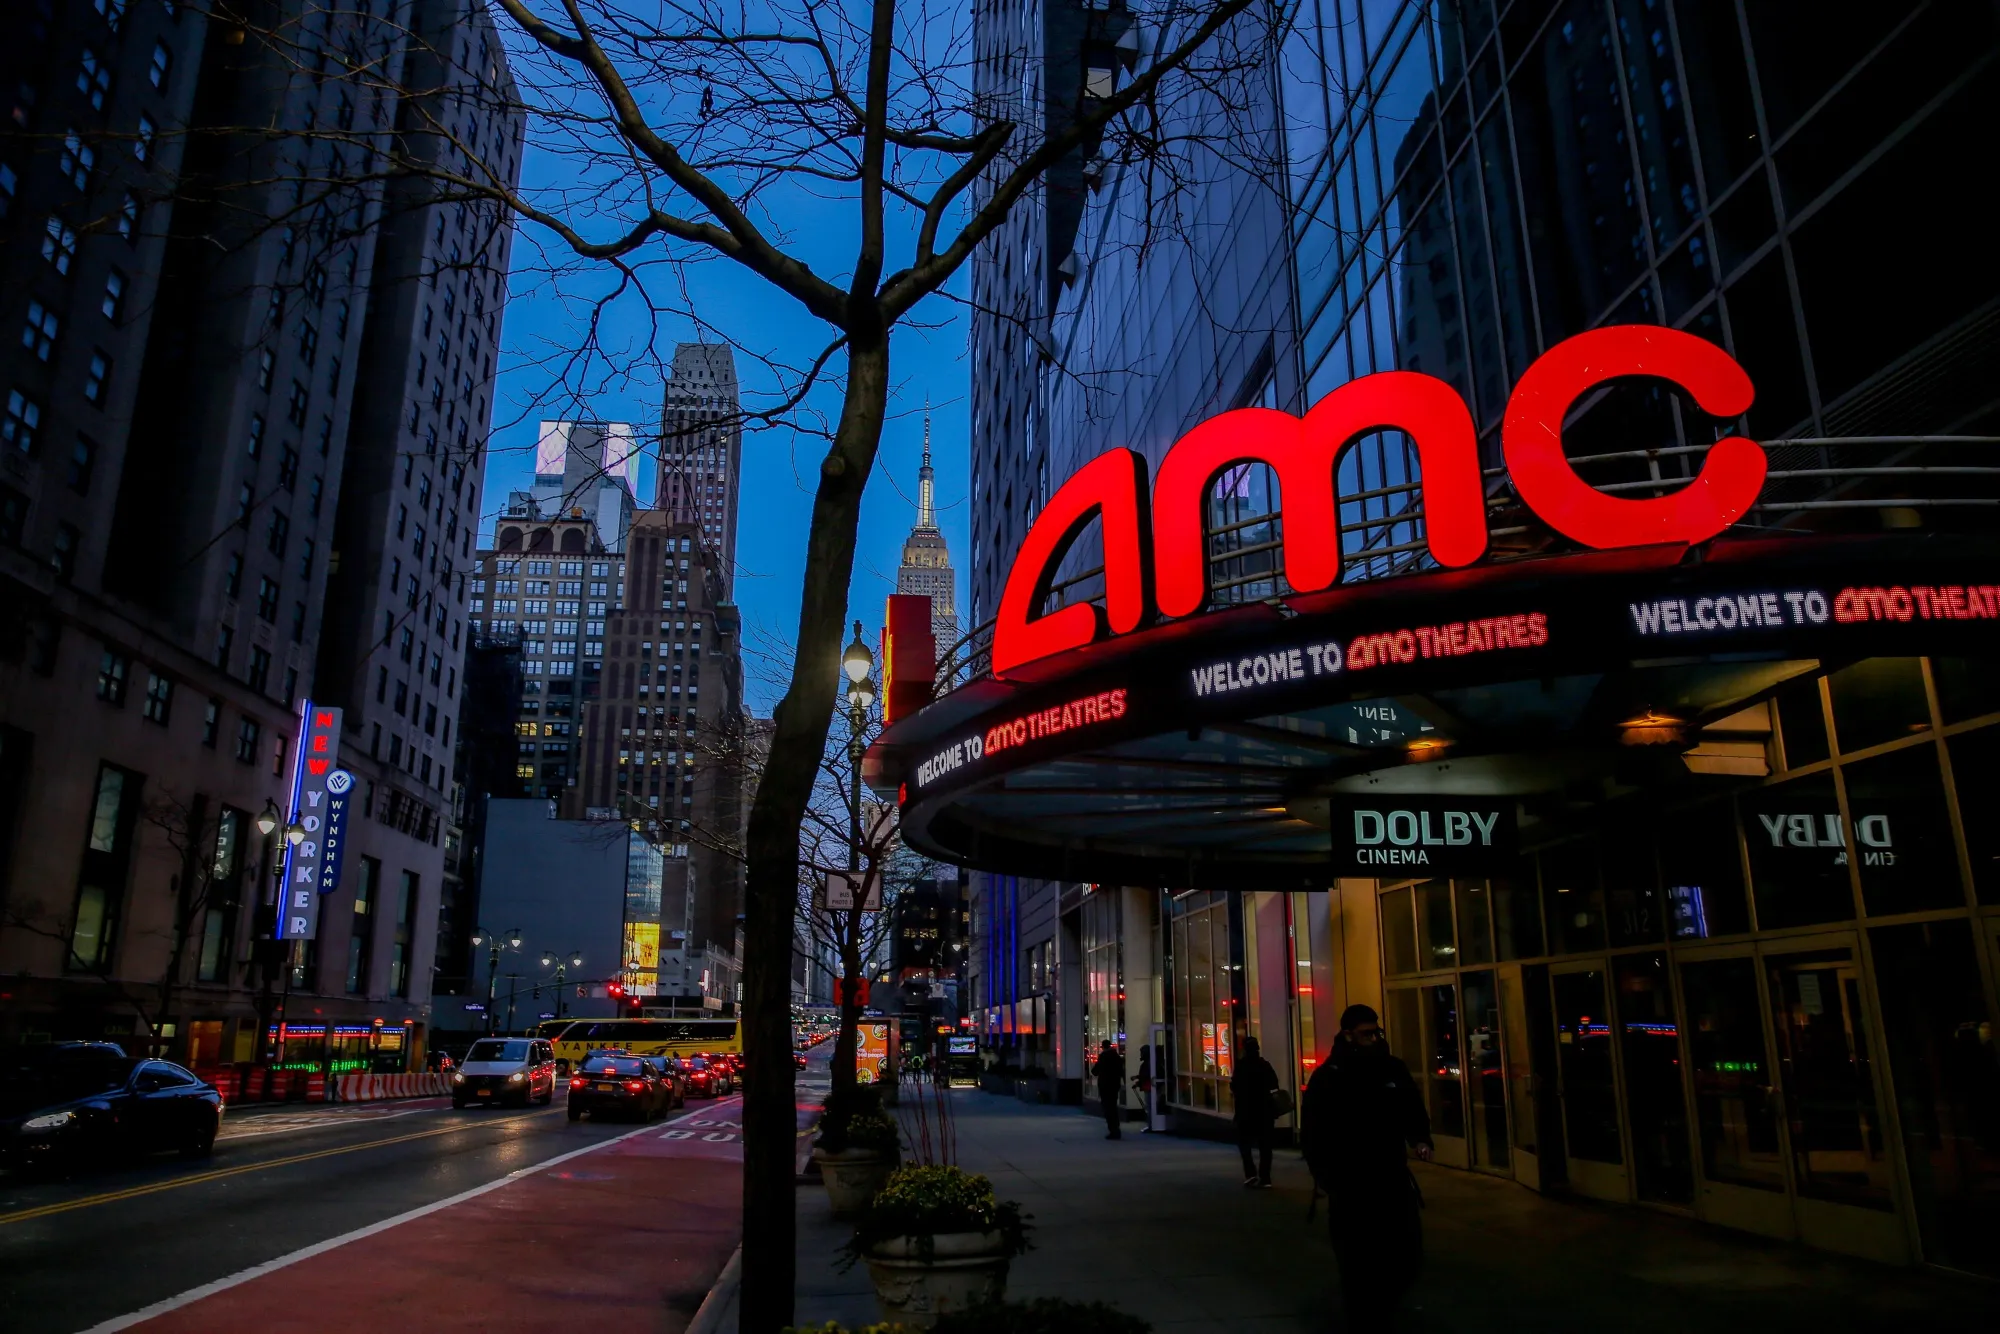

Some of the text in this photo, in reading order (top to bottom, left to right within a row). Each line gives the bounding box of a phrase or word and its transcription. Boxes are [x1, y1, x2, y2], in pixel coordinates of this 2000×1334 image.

[1629, 592, 1784, 635] WELCOME
[1784, 590, 1828, 624] TO
[1911, 584, 2000, 621] THEAT
[1191, 648, 1305, 697] WELCOME
[1306, 642, 1342, 675] TO
[1417, 611, 1549, 658] THEATRES
[308, 711, 333, 776] NEW
[917, 744, 963, 787] WELCOME
[964, 735, 983, 763] TO
[1027, 688, 1128, 740] THEATRES
[322, 800, 344, 888] WYNDHAM
[1353, 809, 1500, 847] DOLBY
[1356, 848, 1430, 866] CINEMA
[289, 790, 324, 934] YORKER
[562, 1042, 633, 1051] YANKEE
[658, 1130, 736, 1142] BU
